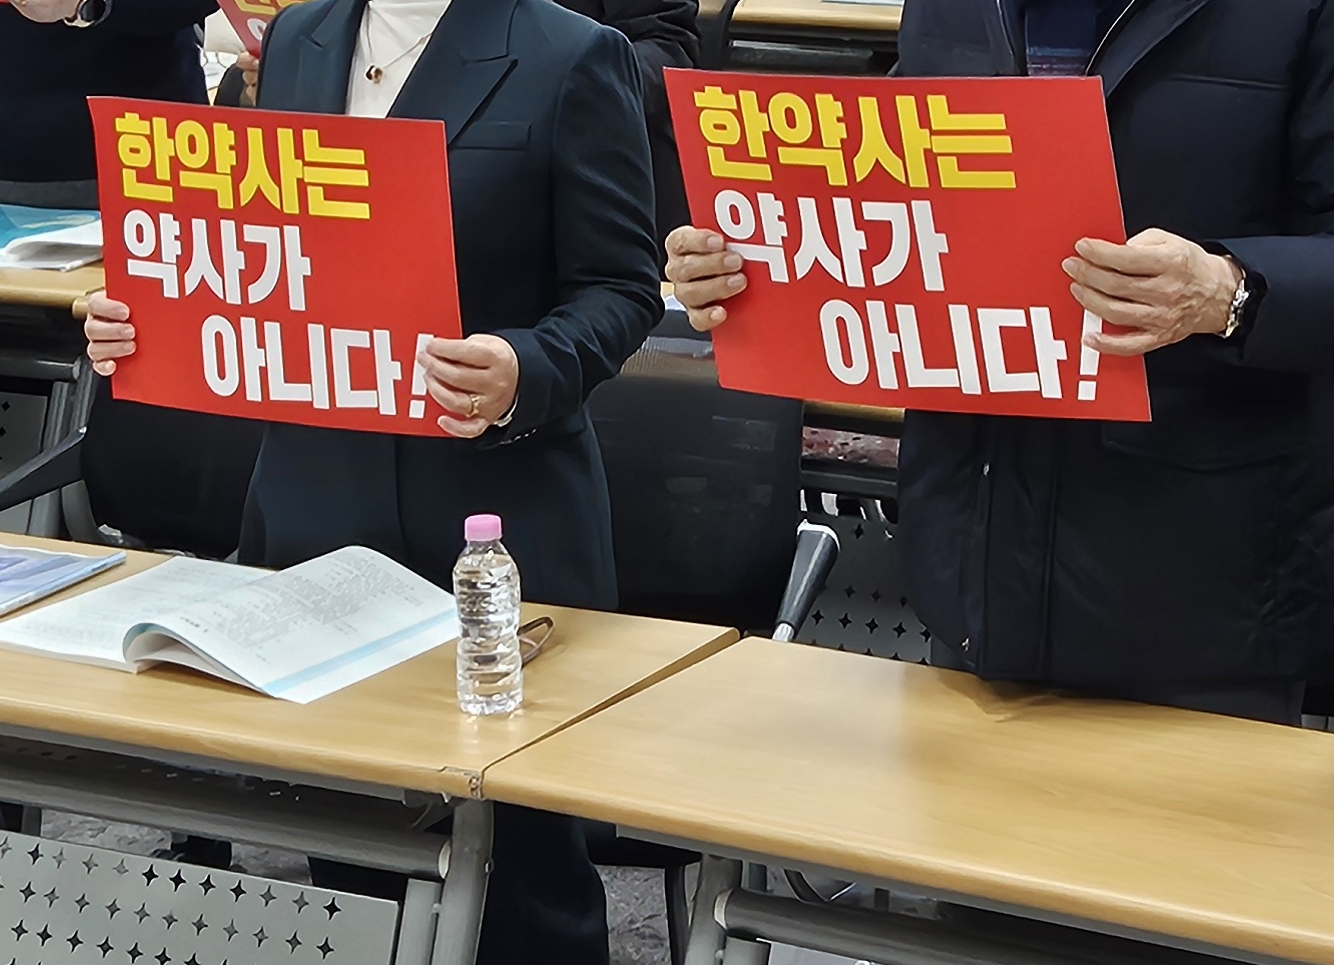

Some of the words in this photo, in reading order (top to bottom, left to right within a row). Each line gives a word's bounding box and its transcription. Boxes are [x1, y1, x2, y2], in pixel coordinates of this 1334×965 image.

[114, 110, 371, 221] 한약사는
[693, 84, 1017, 190] 한약사는
[122, 208, 312, 312] 약사가
[713, 188, 950, 293] 약사가
[200, 314, 435, 420] 아니다!
[818, 298, 1104, 401] 아니다!
